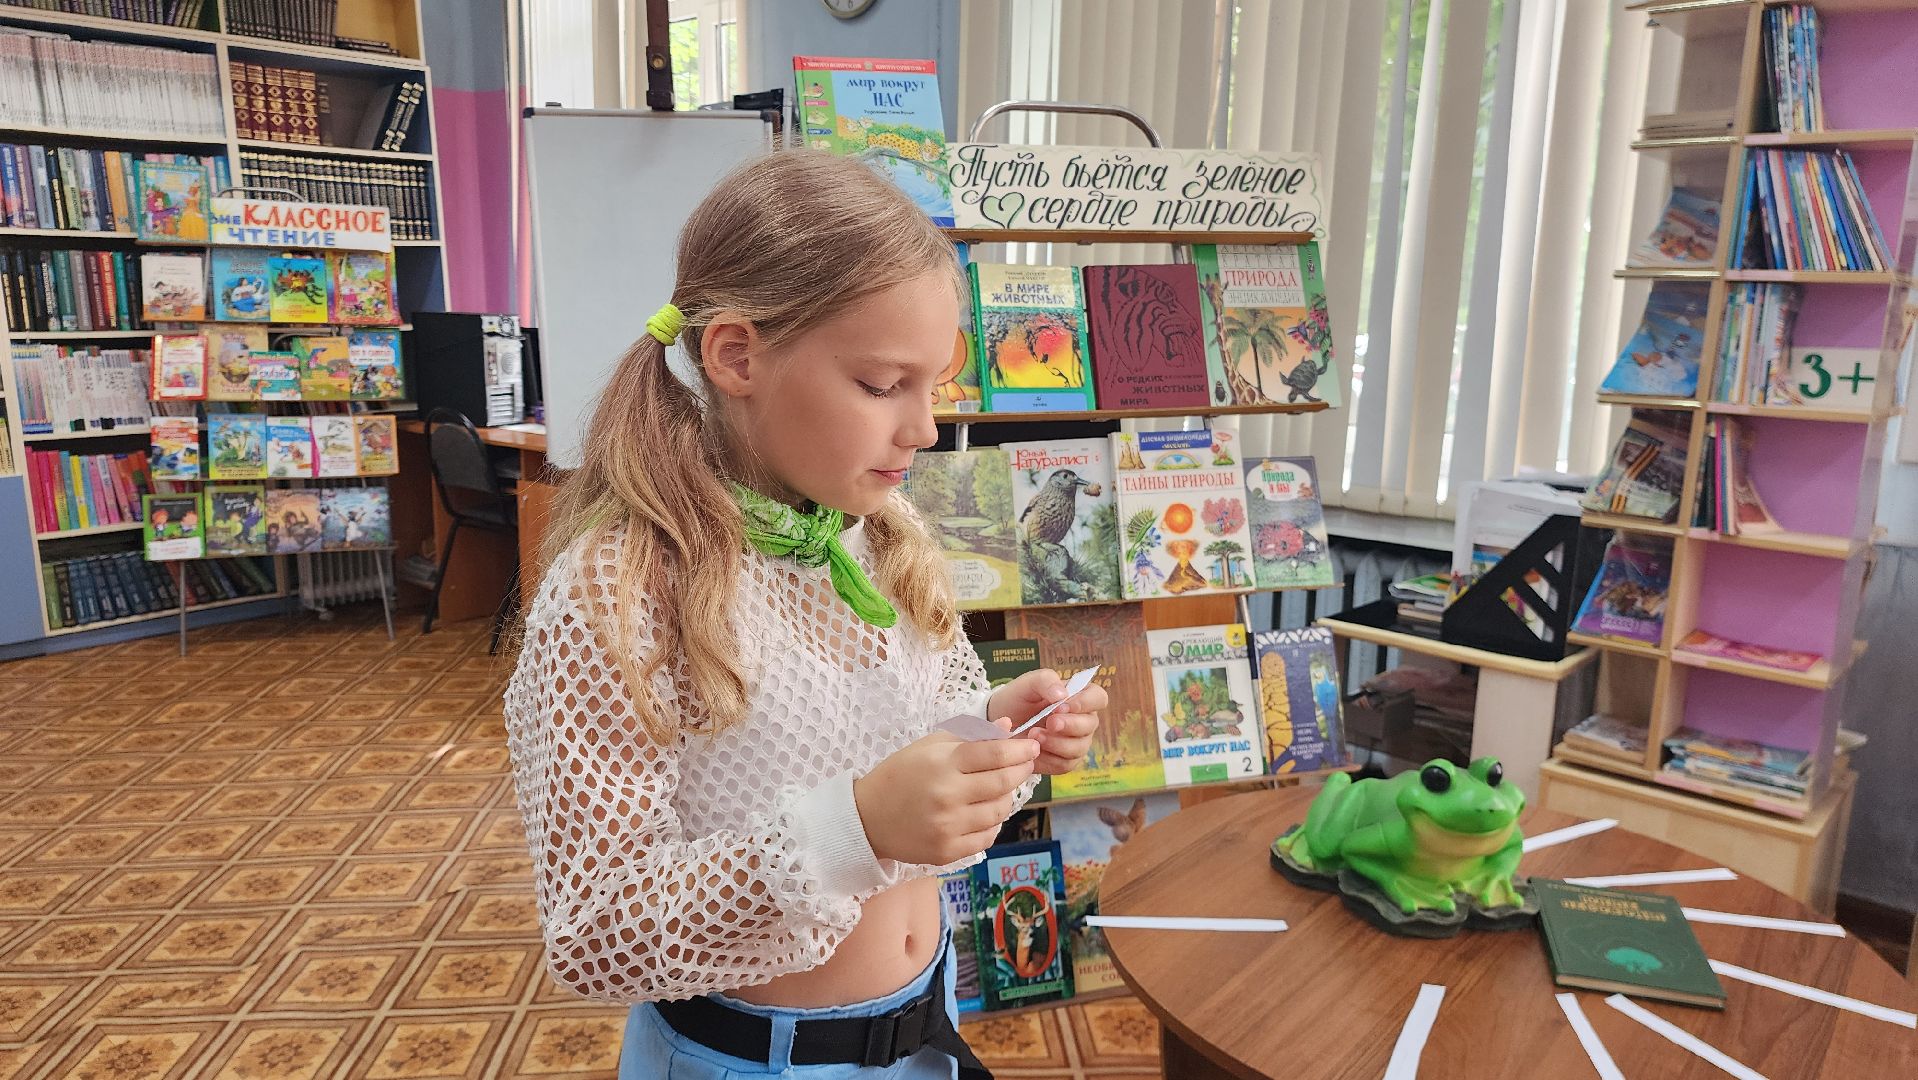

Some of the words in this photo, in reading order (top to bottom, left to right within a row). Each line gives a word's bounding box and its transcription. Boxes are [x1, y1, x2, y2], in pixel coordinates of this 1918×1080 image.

[873, 92, 904, 107] НАС
[951, 145, 1050, 202] Пусть
[1062, 154, 1167, 192] бьётся
[1028, 191, 1138, 230] сердце
[1152, 196, 1315, 231] природы
[228, 228, 336, 246] ЧТЕНИЕ
[1224, 270, 1298, 288] ПРИРОДА
[1005, 284, 1013, 292] В
[1017, 284, 1049, 293] МИРЕ
[992, 293, 1065, 304] ЖИВОТНЫХ
[1126, 375, 1164, 384] РЕДКИХ
[1799, 354, 1875, 398] 3+
[1132, 385, 1205, 394] ЖИВОТНЫХ
[1120, 398, 1149, 406] МИРА
[1122, 474, 1169, 492] ТАЙНЫ
[1172, 472, 1235, 490] ПРИРОДЫ
[992, 647, 1034, 656] ПРИЧУДЫ
[1186, 643, 1224, 657] МИР
[1068, 654, 1104, 664] ГАЛКИН
[1163, 747, 1183, 758] МИР
[1188, 743, 1228, 756] ВОКРУГ
[1229, 740, 1251, 751] НАС
[1242, 756, 1253, 772] 2
[1001, 859, 1040, 884] ВСЁ
